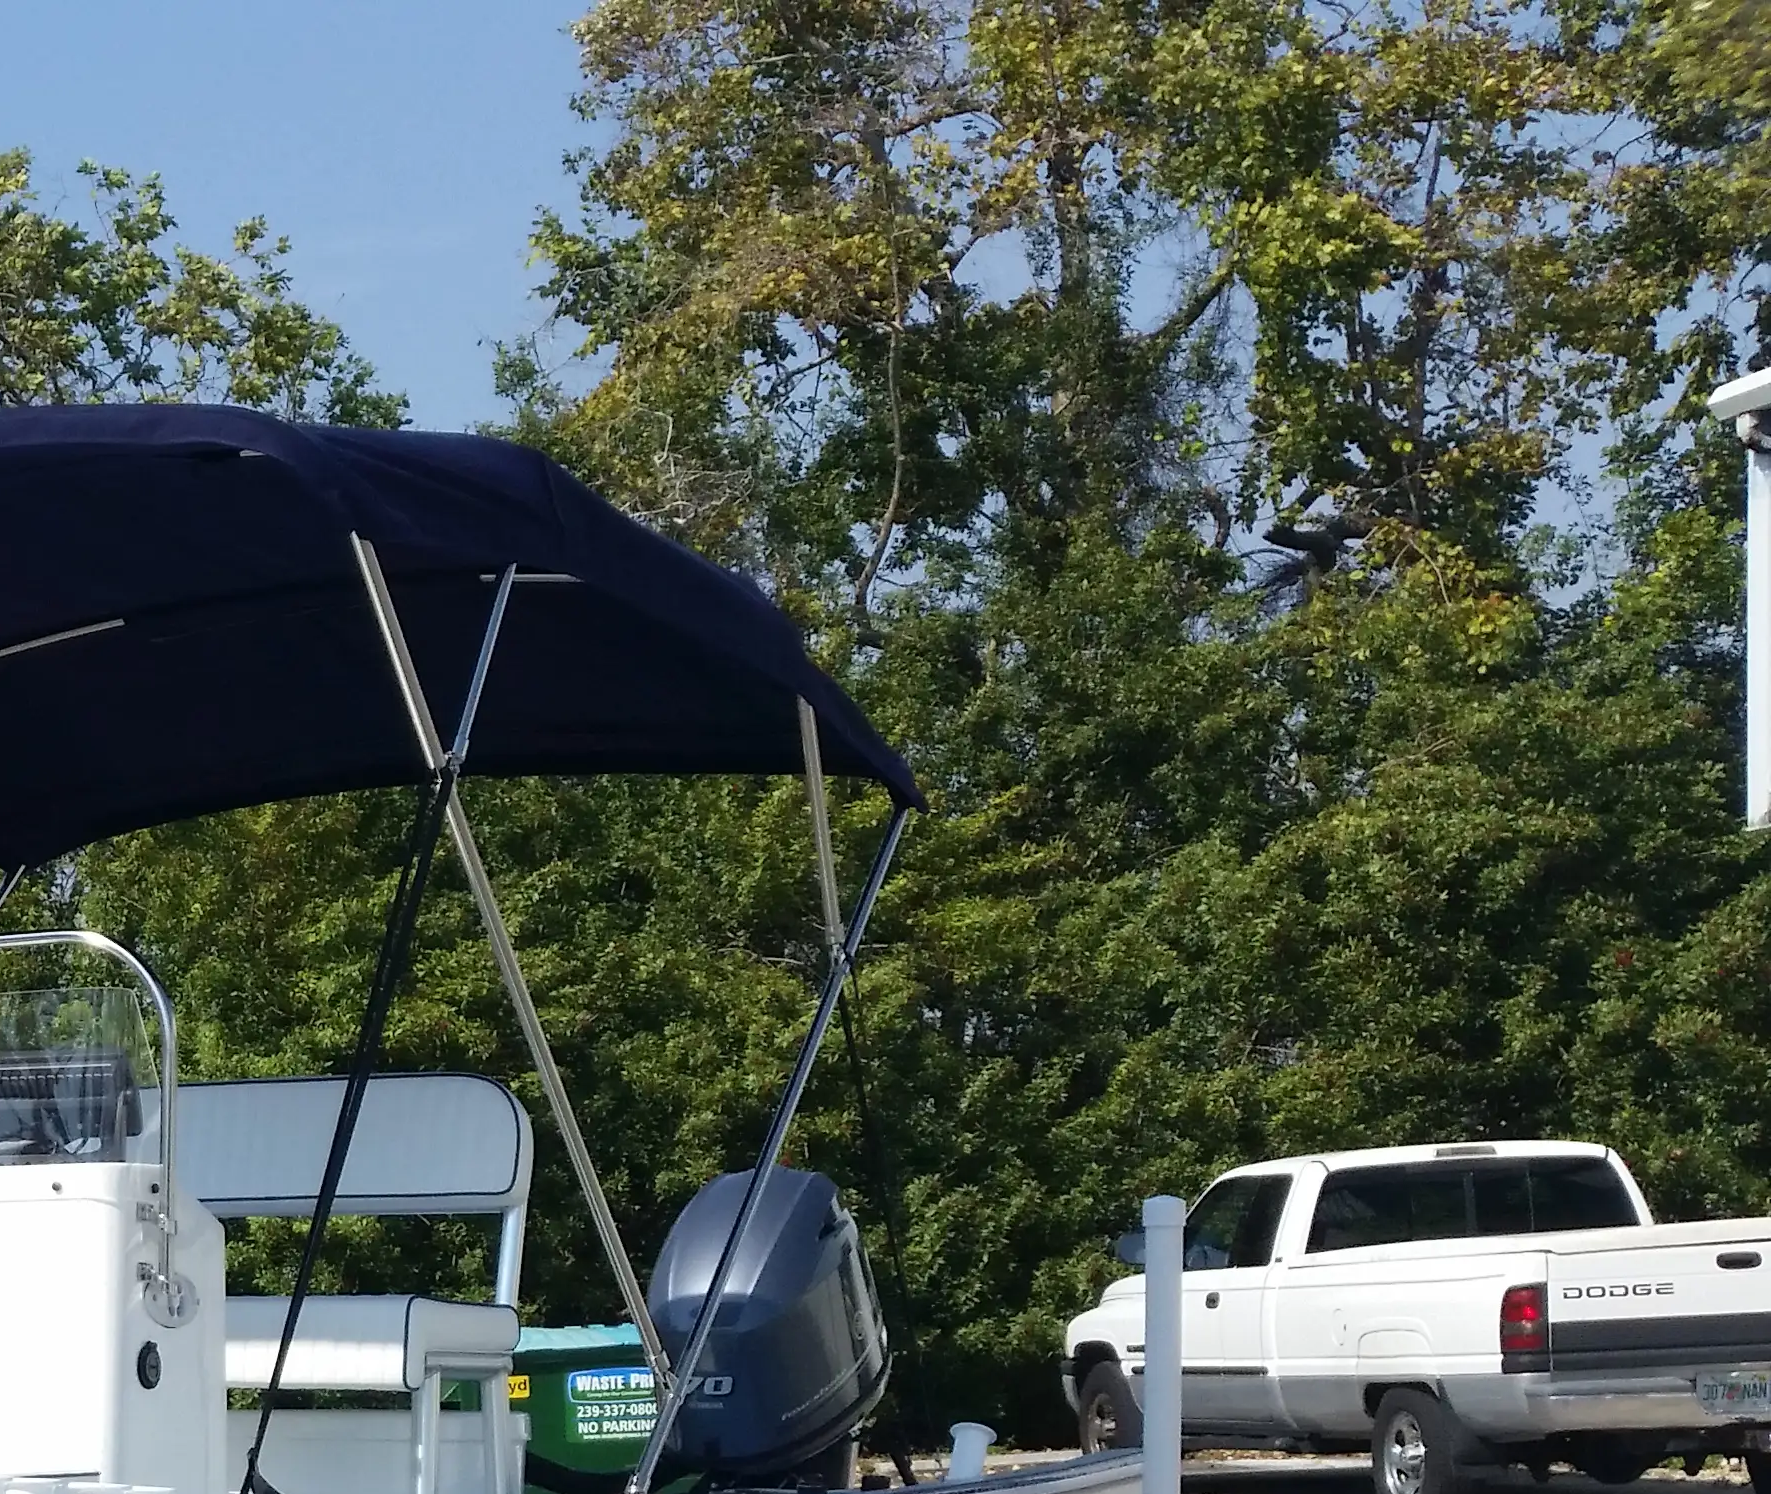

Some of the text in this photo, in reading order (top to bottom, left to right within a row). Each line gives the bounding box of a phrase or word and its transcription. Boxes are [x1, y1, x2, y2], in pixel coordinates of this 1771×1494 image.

[1563, 1283, 1675, 1299] DODGE
[576, 1375, 625, 1391] WASTE
[578, 1421, 599, 1433] NO
